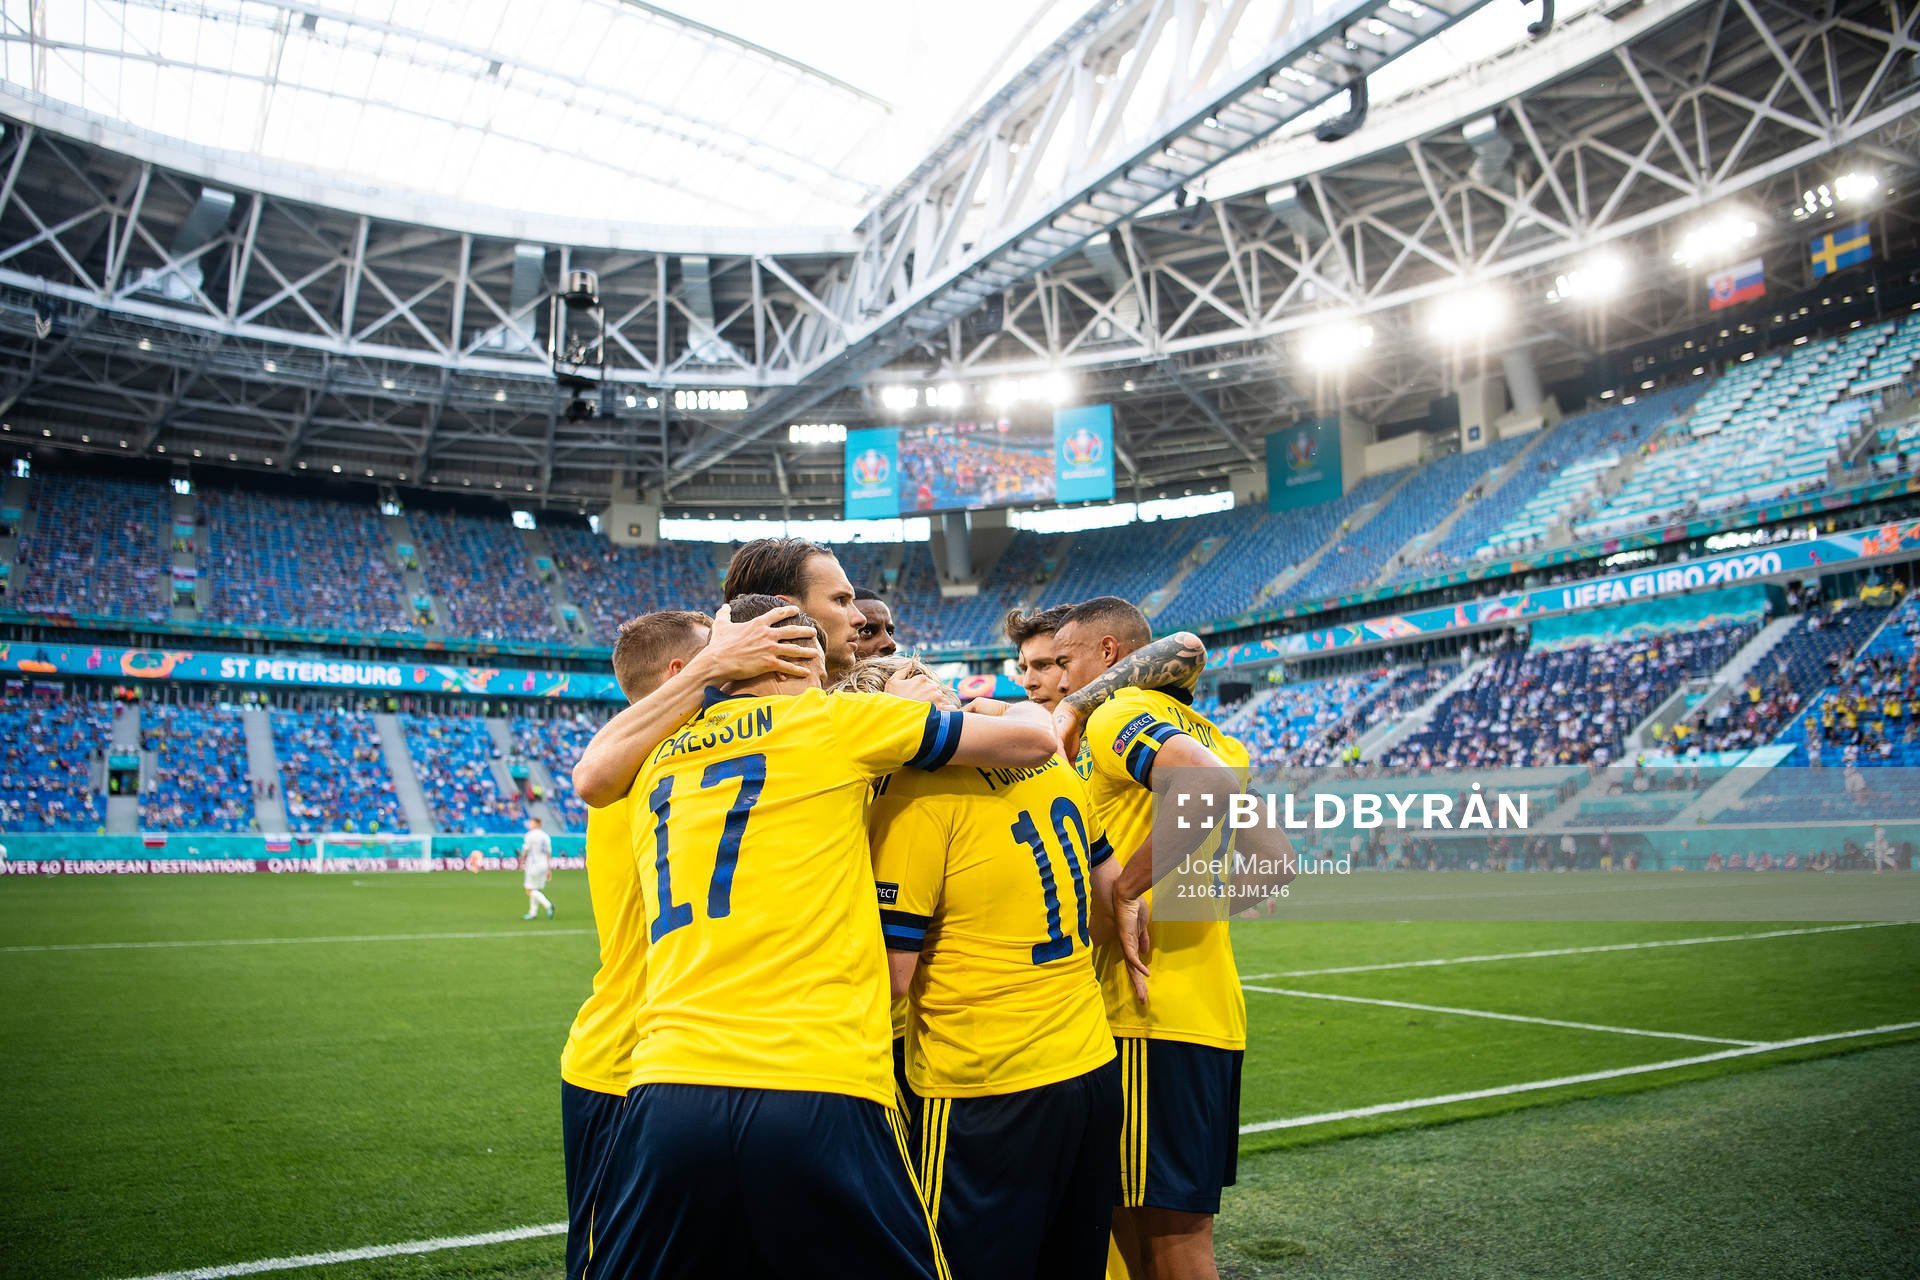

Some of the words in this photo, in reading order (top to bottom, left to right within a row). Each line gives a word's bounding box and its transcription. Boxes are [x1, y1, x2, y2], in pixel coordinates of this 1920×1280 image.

[1563, 580, 1627, 609] UEFA
[1631, 566, 1704, 598] EURO
[1708, 552, 1782, 584] 2020
[220, 658, 250, 679] ST
[255, 660, 402, 686] PETERSBURG
[1121, 714, 1153, 741] RESPECT
[40, 860, 61, 874] 40
[64, 860, 148, 874] EUROPEAN
[151, 859, 257, 874] DESTINATIONS
[649, 753, 767, 945] 17
[1011, 797, 1092, 965] 10
